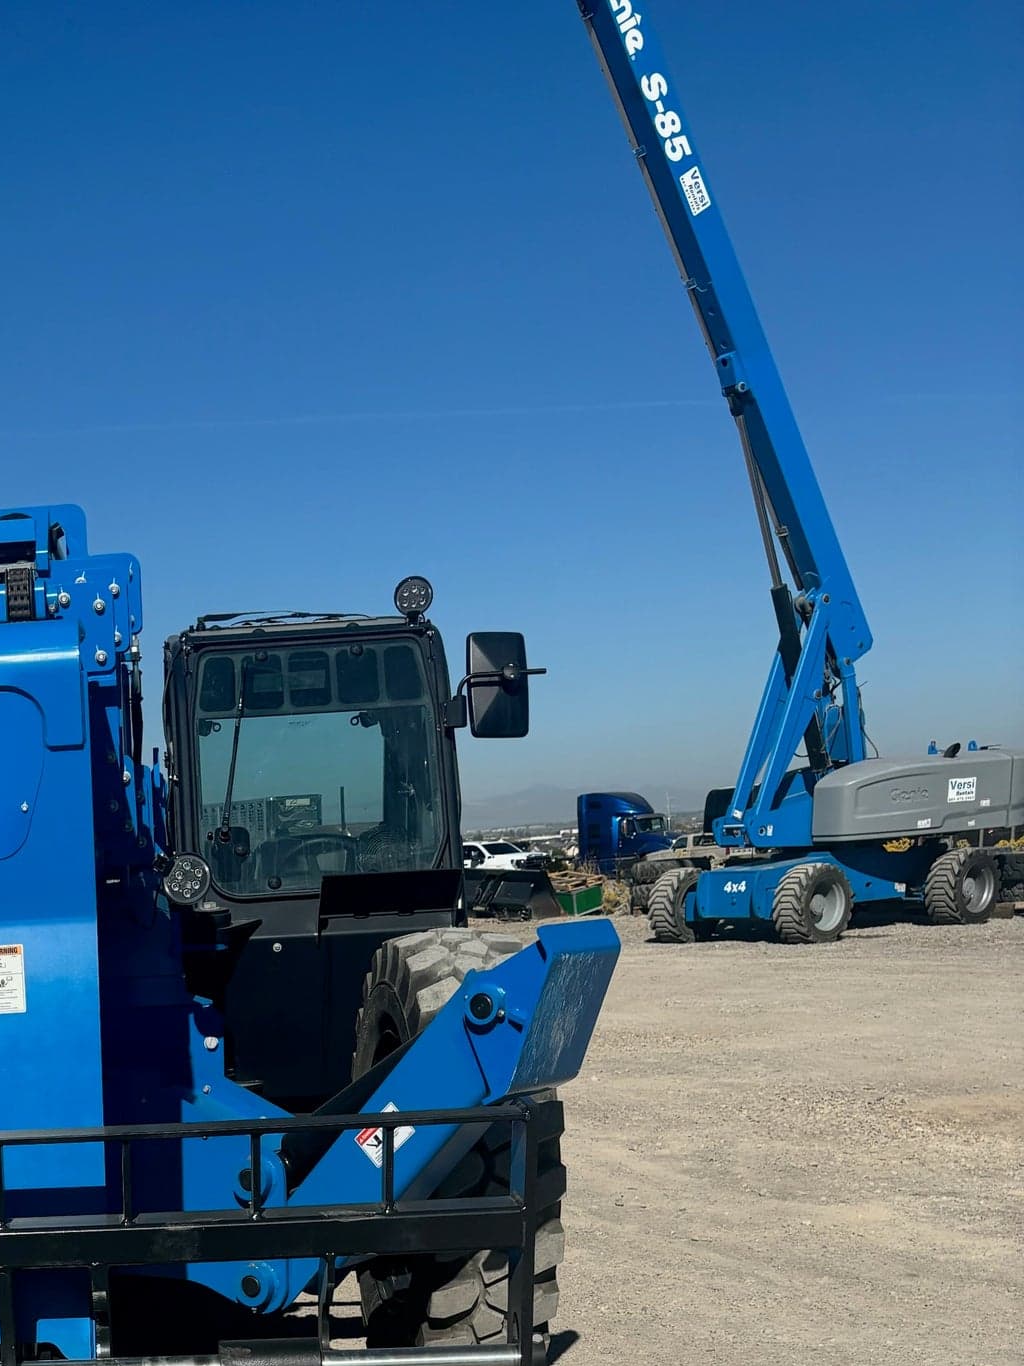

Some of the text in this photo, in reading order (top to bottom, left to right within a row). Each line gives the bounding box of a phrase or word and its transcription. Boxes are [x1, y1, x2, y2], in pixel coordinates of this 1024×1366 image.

[641, 72, 692, 161] S-85
[691, 169, 709, 207] Versi
[950, 779, 975, 790] Versi
[724, 880, 746, 893] 4x4
